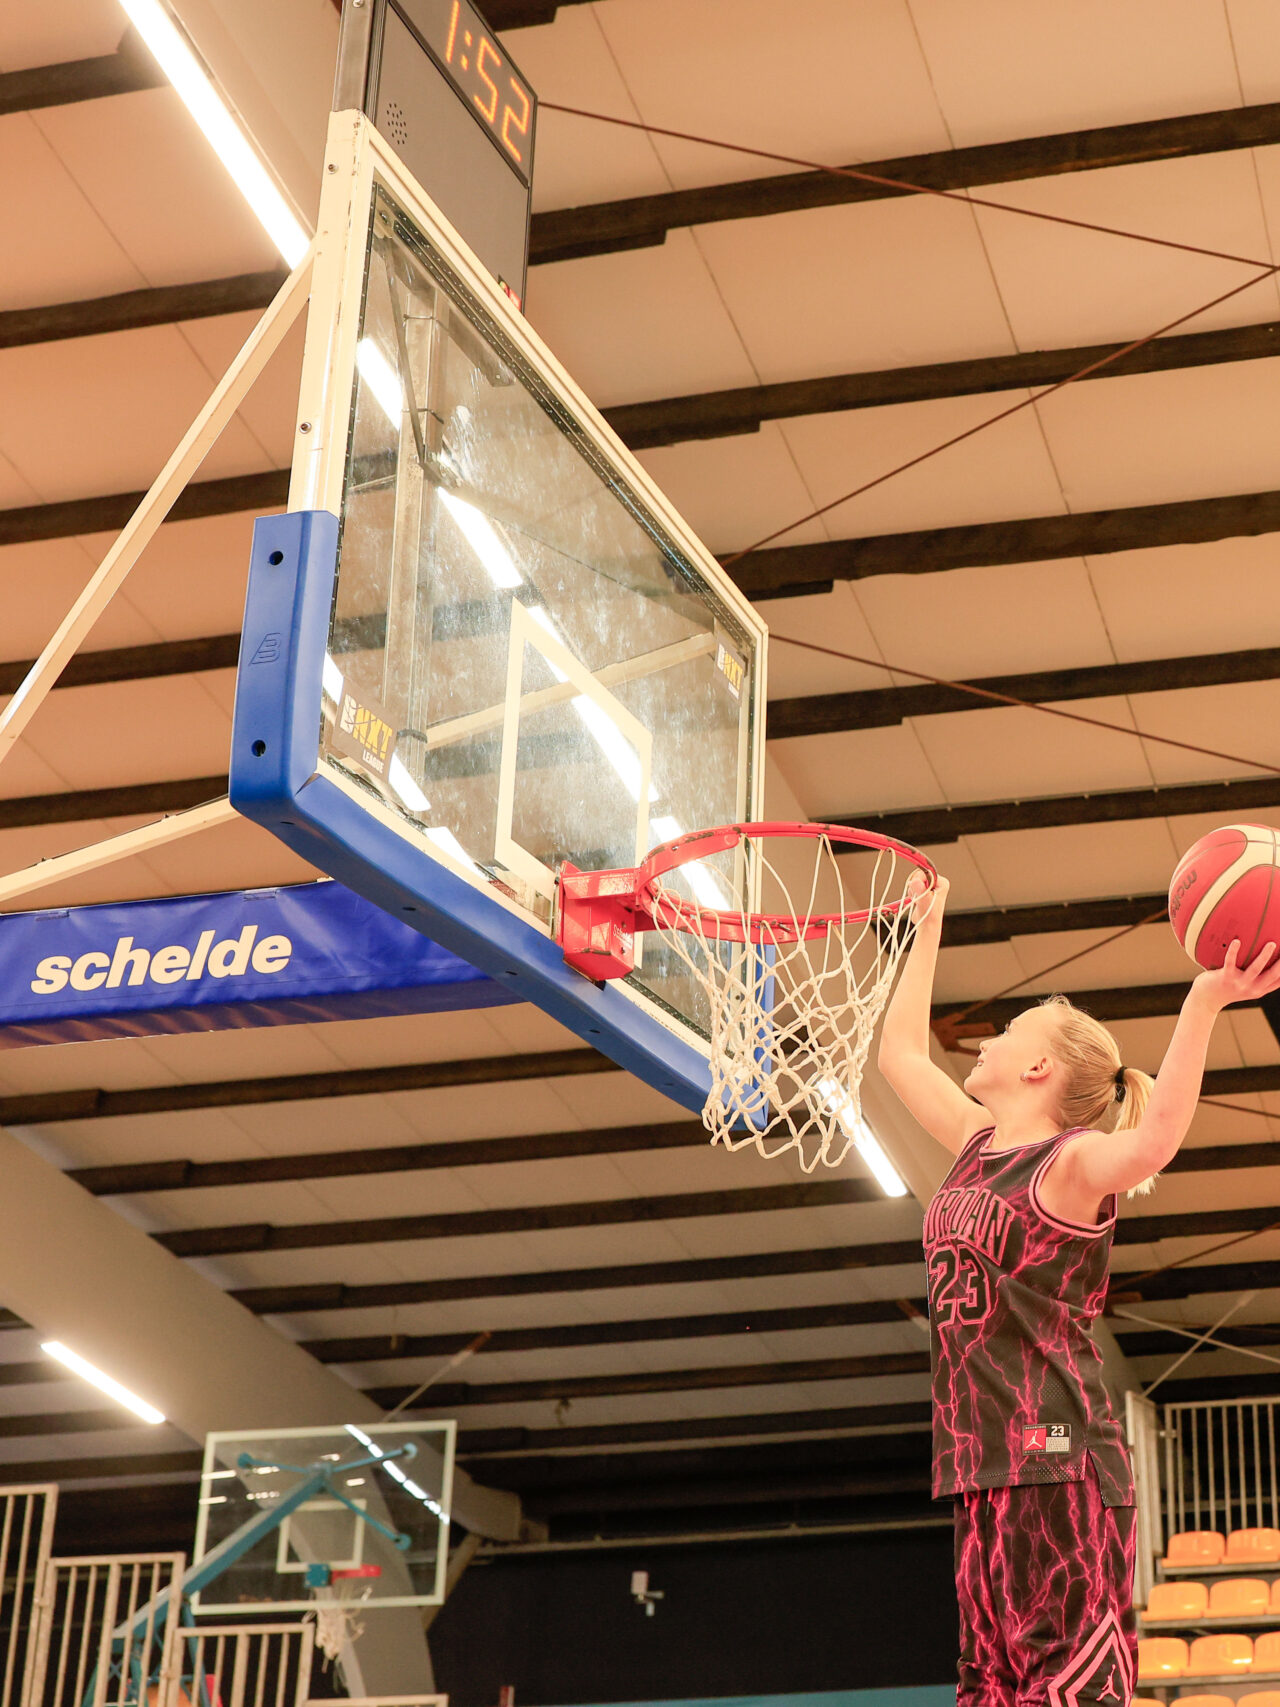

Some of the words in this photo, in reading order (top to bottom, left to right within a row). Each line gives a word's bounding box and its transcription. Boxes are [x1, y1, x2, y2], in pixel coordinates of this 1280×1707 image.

[445, 0, 531, 163] 1:52
[31, 924, 293, 994] schelde
[929, 1244, 991, 1329] 23
[1050, 1425, 1065, 1437] 23
